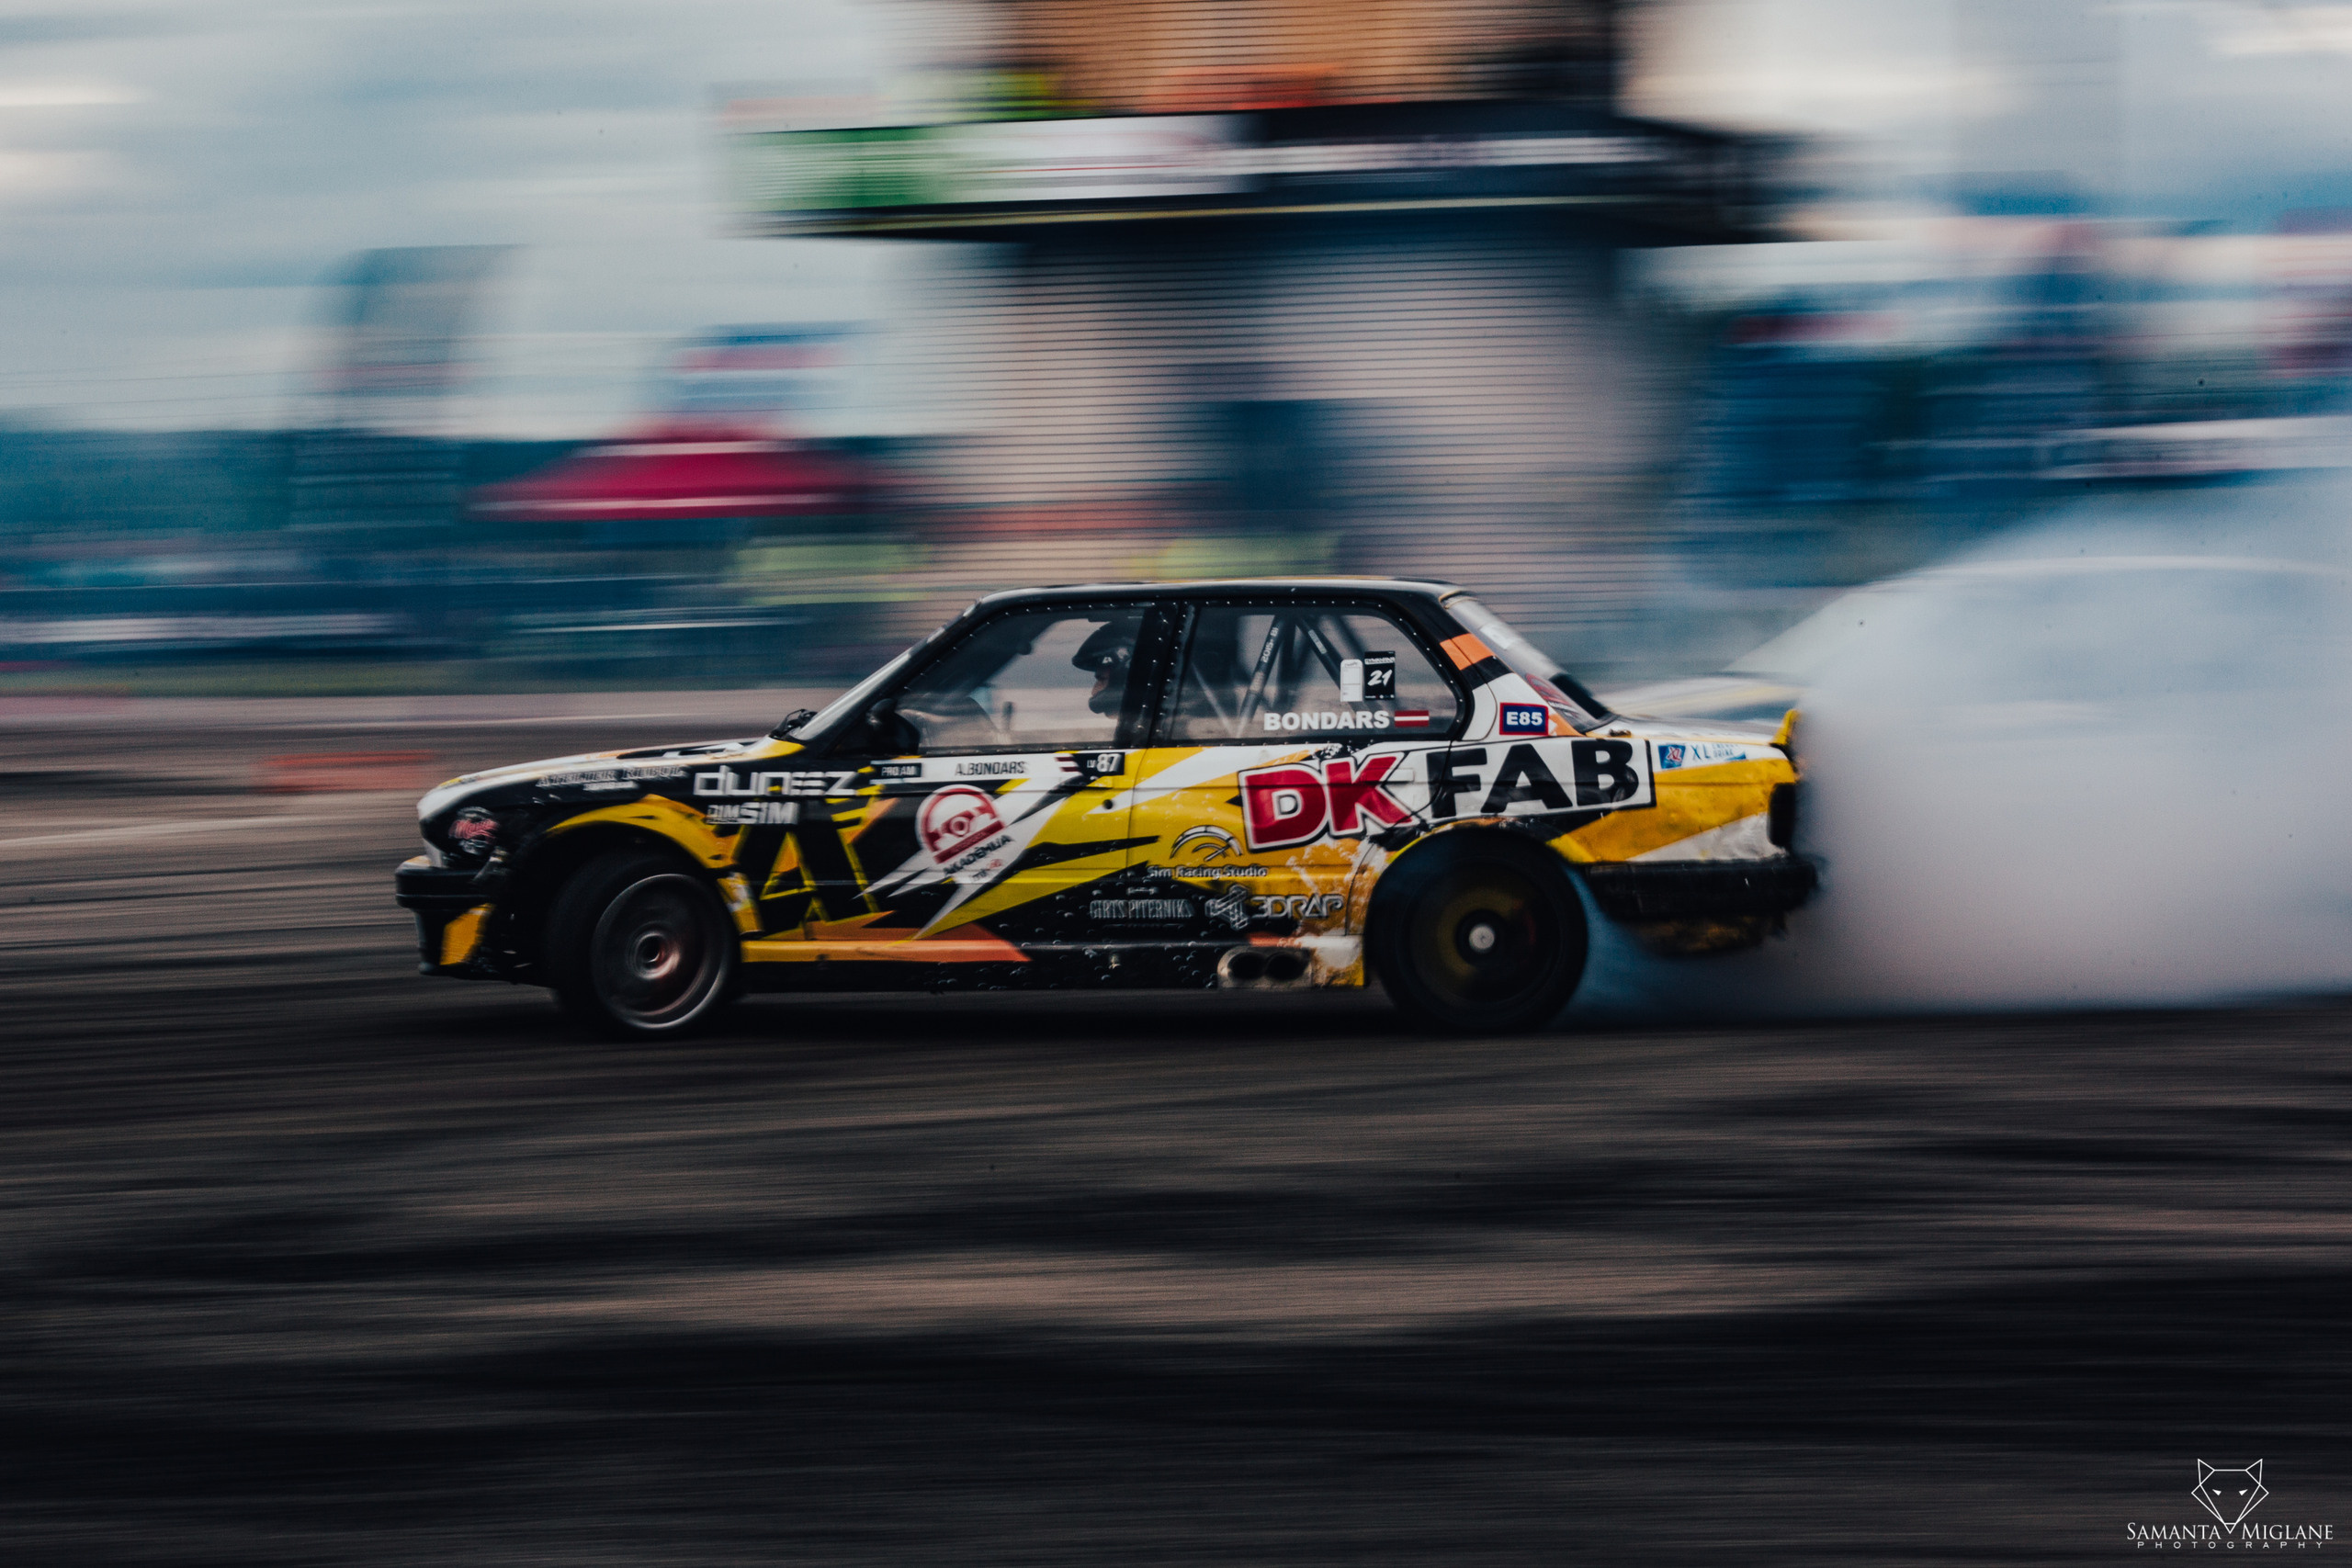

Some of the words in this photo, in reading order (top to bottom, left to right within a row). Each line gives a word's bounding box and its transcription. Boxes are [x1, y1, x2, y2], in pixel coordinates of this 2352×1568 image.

[1368, 670, 1393, 686] 21
[1263, 711, 1390, 731] BONDARS
[1506, 711, 1544, 727] E85
[956, 761, 1029, 776] A.BONDARS
[1097, 753, 1122, 773] 87
[1241, 753, 1415, 848] DK
[1426, 739, 1640, 818] FAB
[1148, 865, 1172, 878] Sim
[1176, 866, 1221, 880] Racing
[1222, 864, 1269, 877] Studio
